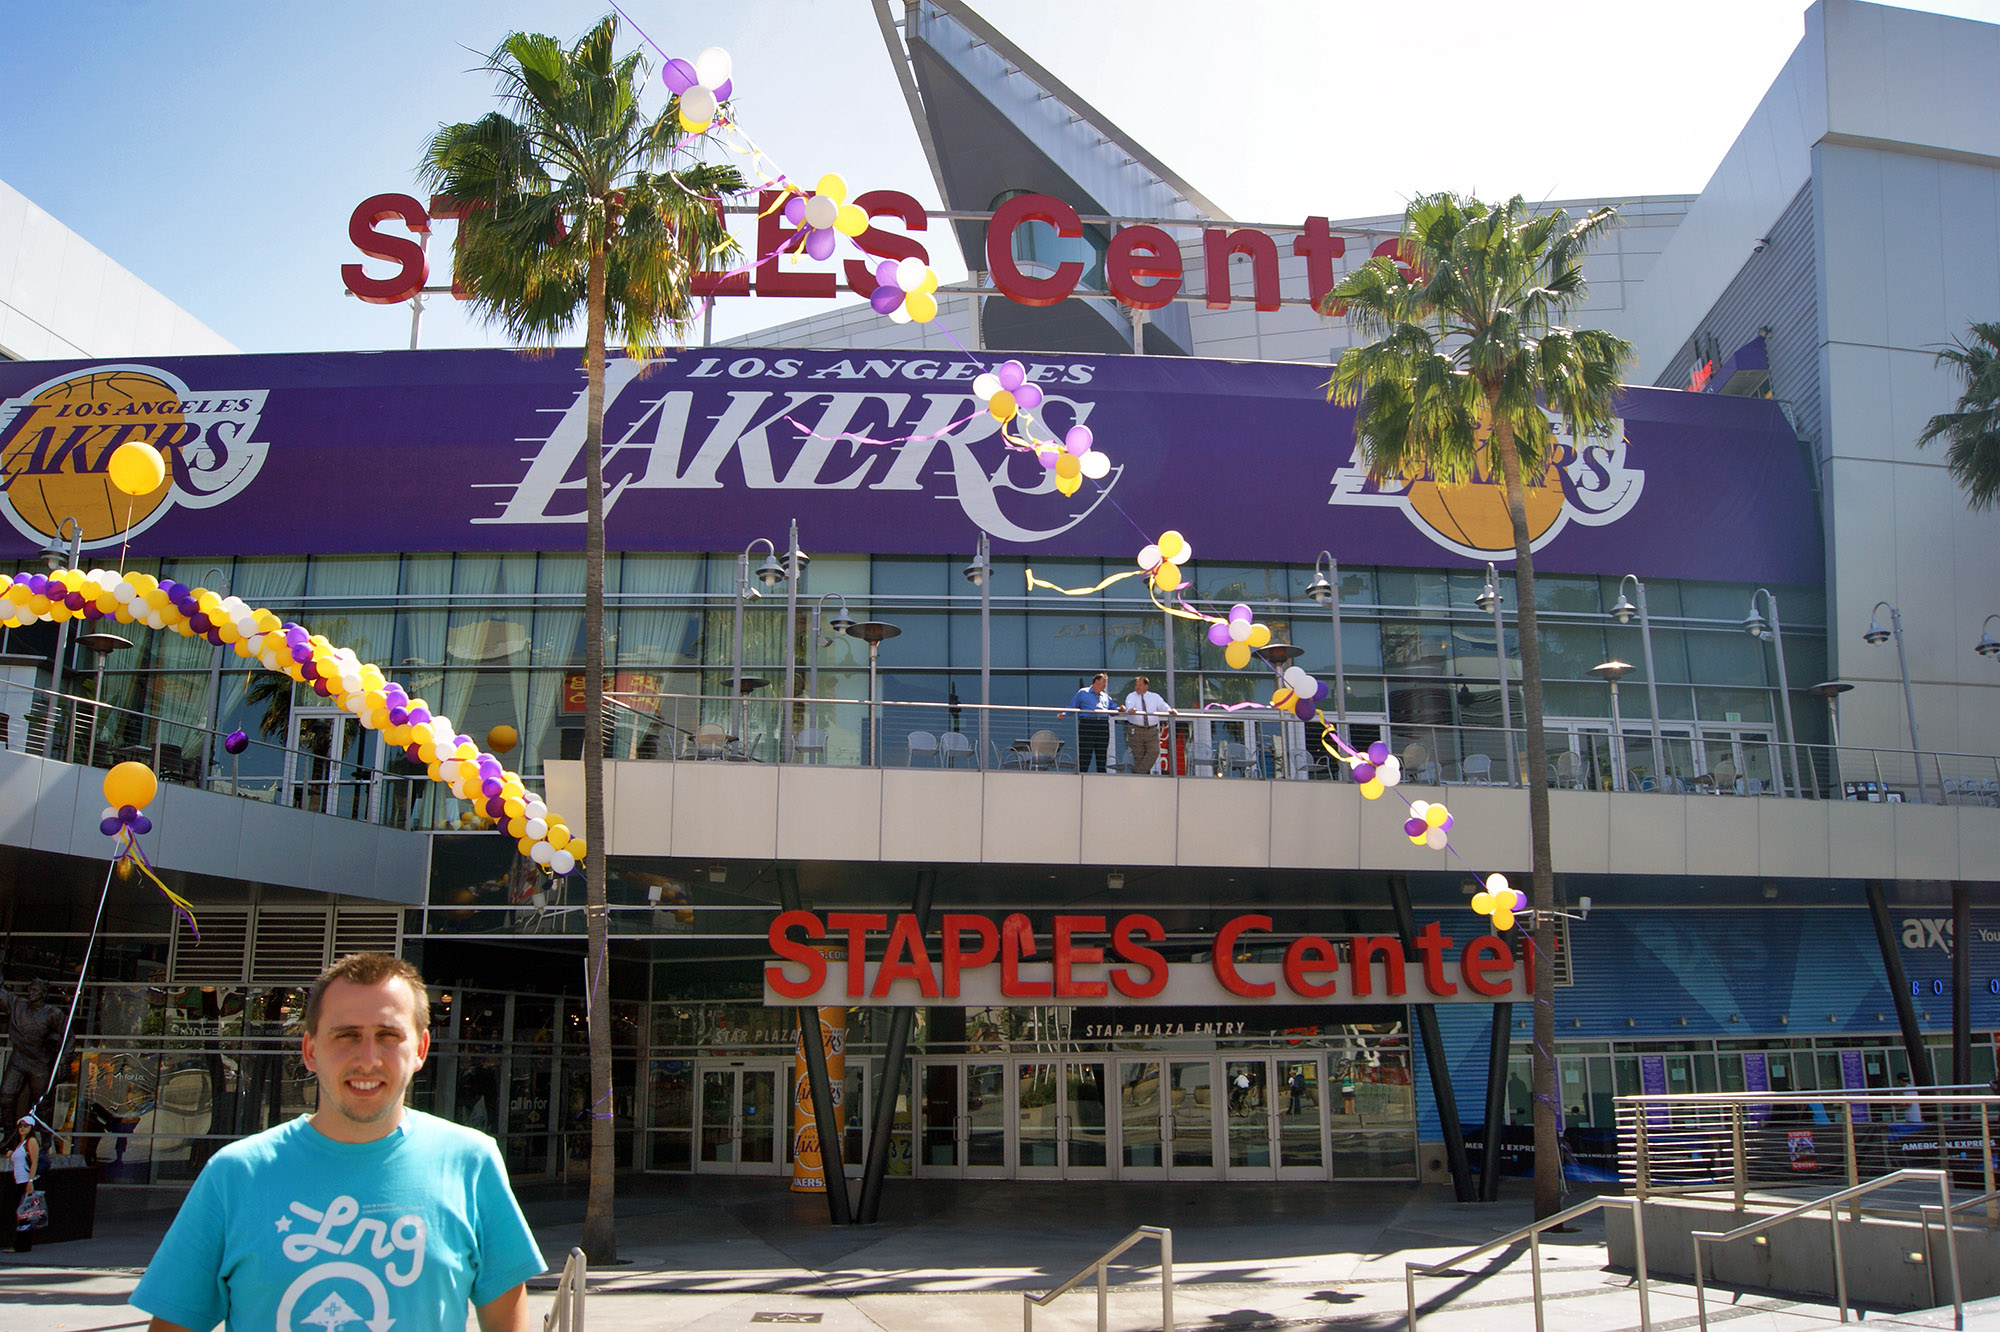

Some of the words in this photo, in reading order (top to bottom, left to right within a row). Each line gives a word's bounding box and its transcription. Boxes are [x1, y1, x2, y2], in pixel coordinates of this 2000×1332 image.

[686, 358, 804, 379] LOS
[55, 401, 111, 418] LOS
[113, 398, 252, 416] ANGELES
[765, 910, 1169, 998] STAPLES
[715, 1029, 748, 1042] STAR
[755, 1028, 797, 1042] PLAZA
[1086, 1023, 1124, 1037] STAR
[1133, 1023, 1185, 1036] PLAZA
[1194, 1022, 1245, 1035] ENTRY
[534, 1096, 548, 1110] for
[1902, 1141, 1952, 1151] AMERICN
[1954, 1139, 1996, 1149] EXPRES
